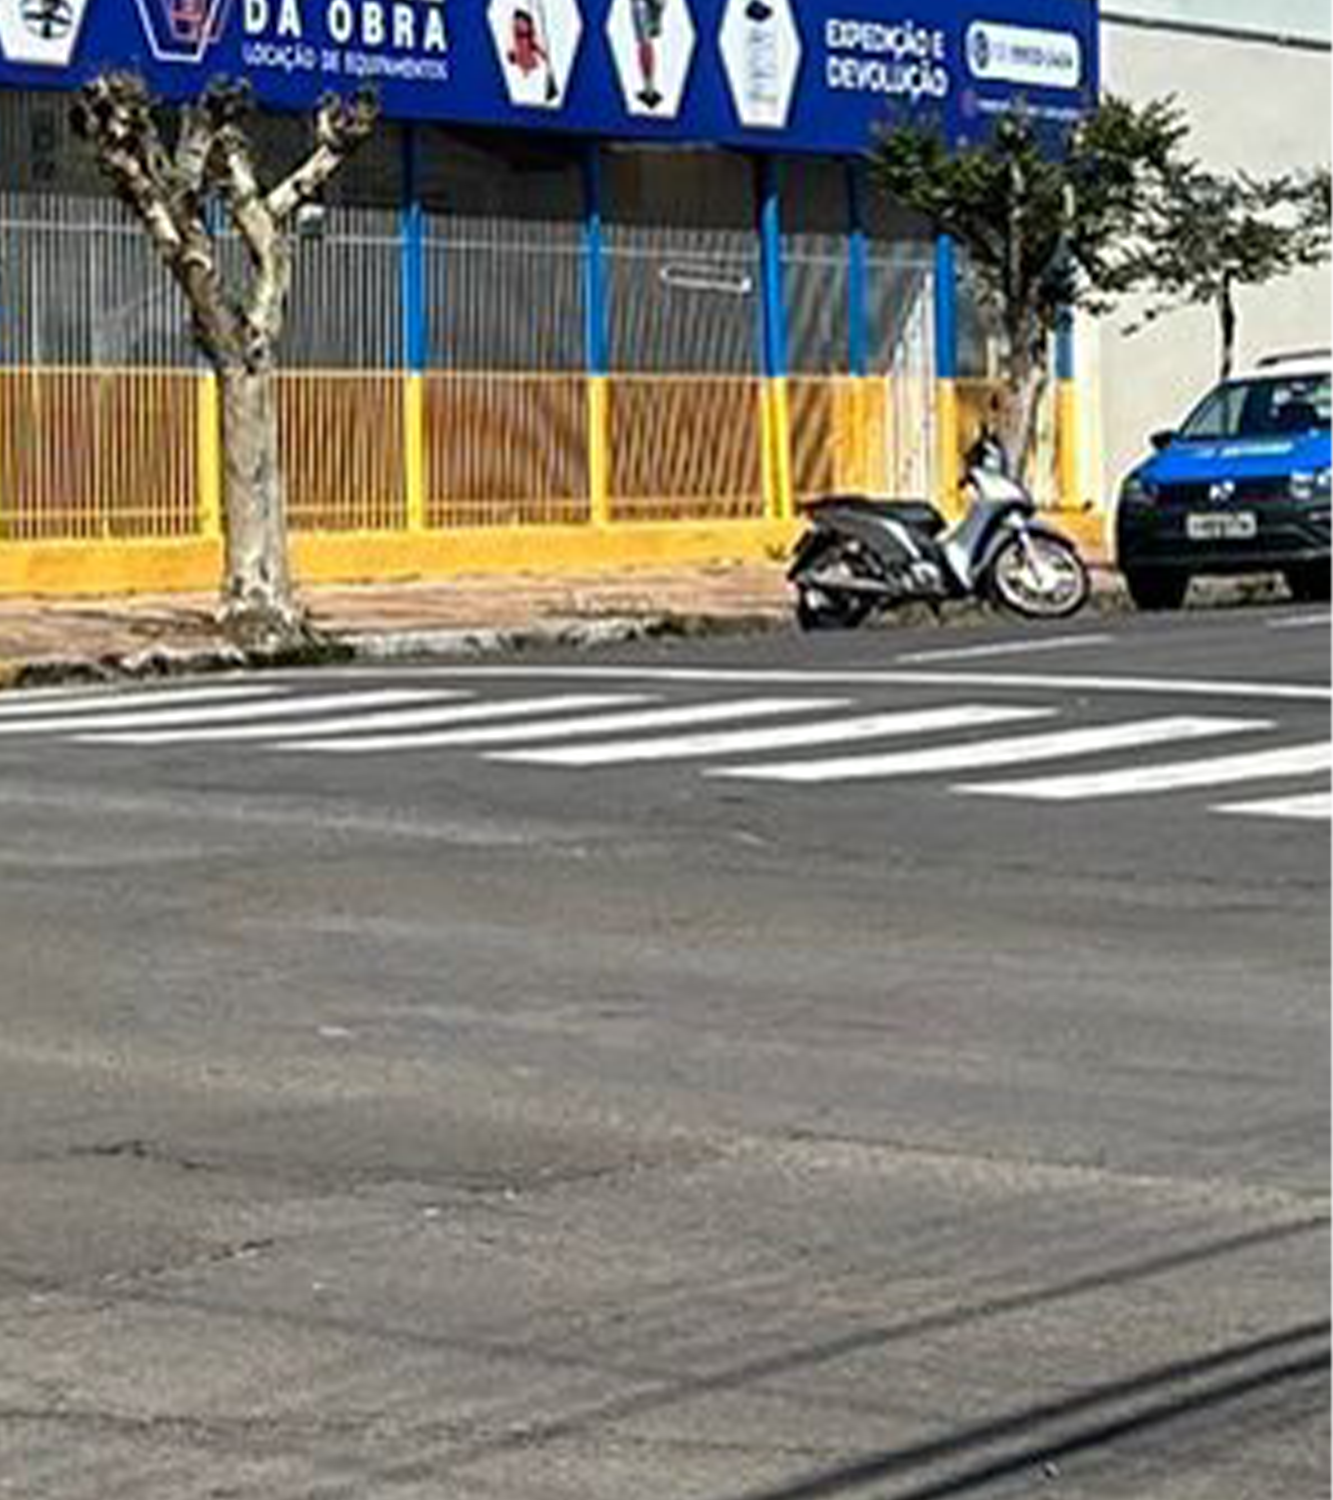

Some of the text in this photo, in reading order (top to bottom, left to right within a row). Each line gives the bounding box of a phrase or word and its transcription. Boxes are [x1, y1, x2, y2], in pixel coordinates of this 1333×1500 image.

[244, 42, 316, 73] LOCAÇÃO
[825, 18, 945, 60] EXPEDIÇÃO E
[826, 56, 949, 104] DEVOLUÇÃO
